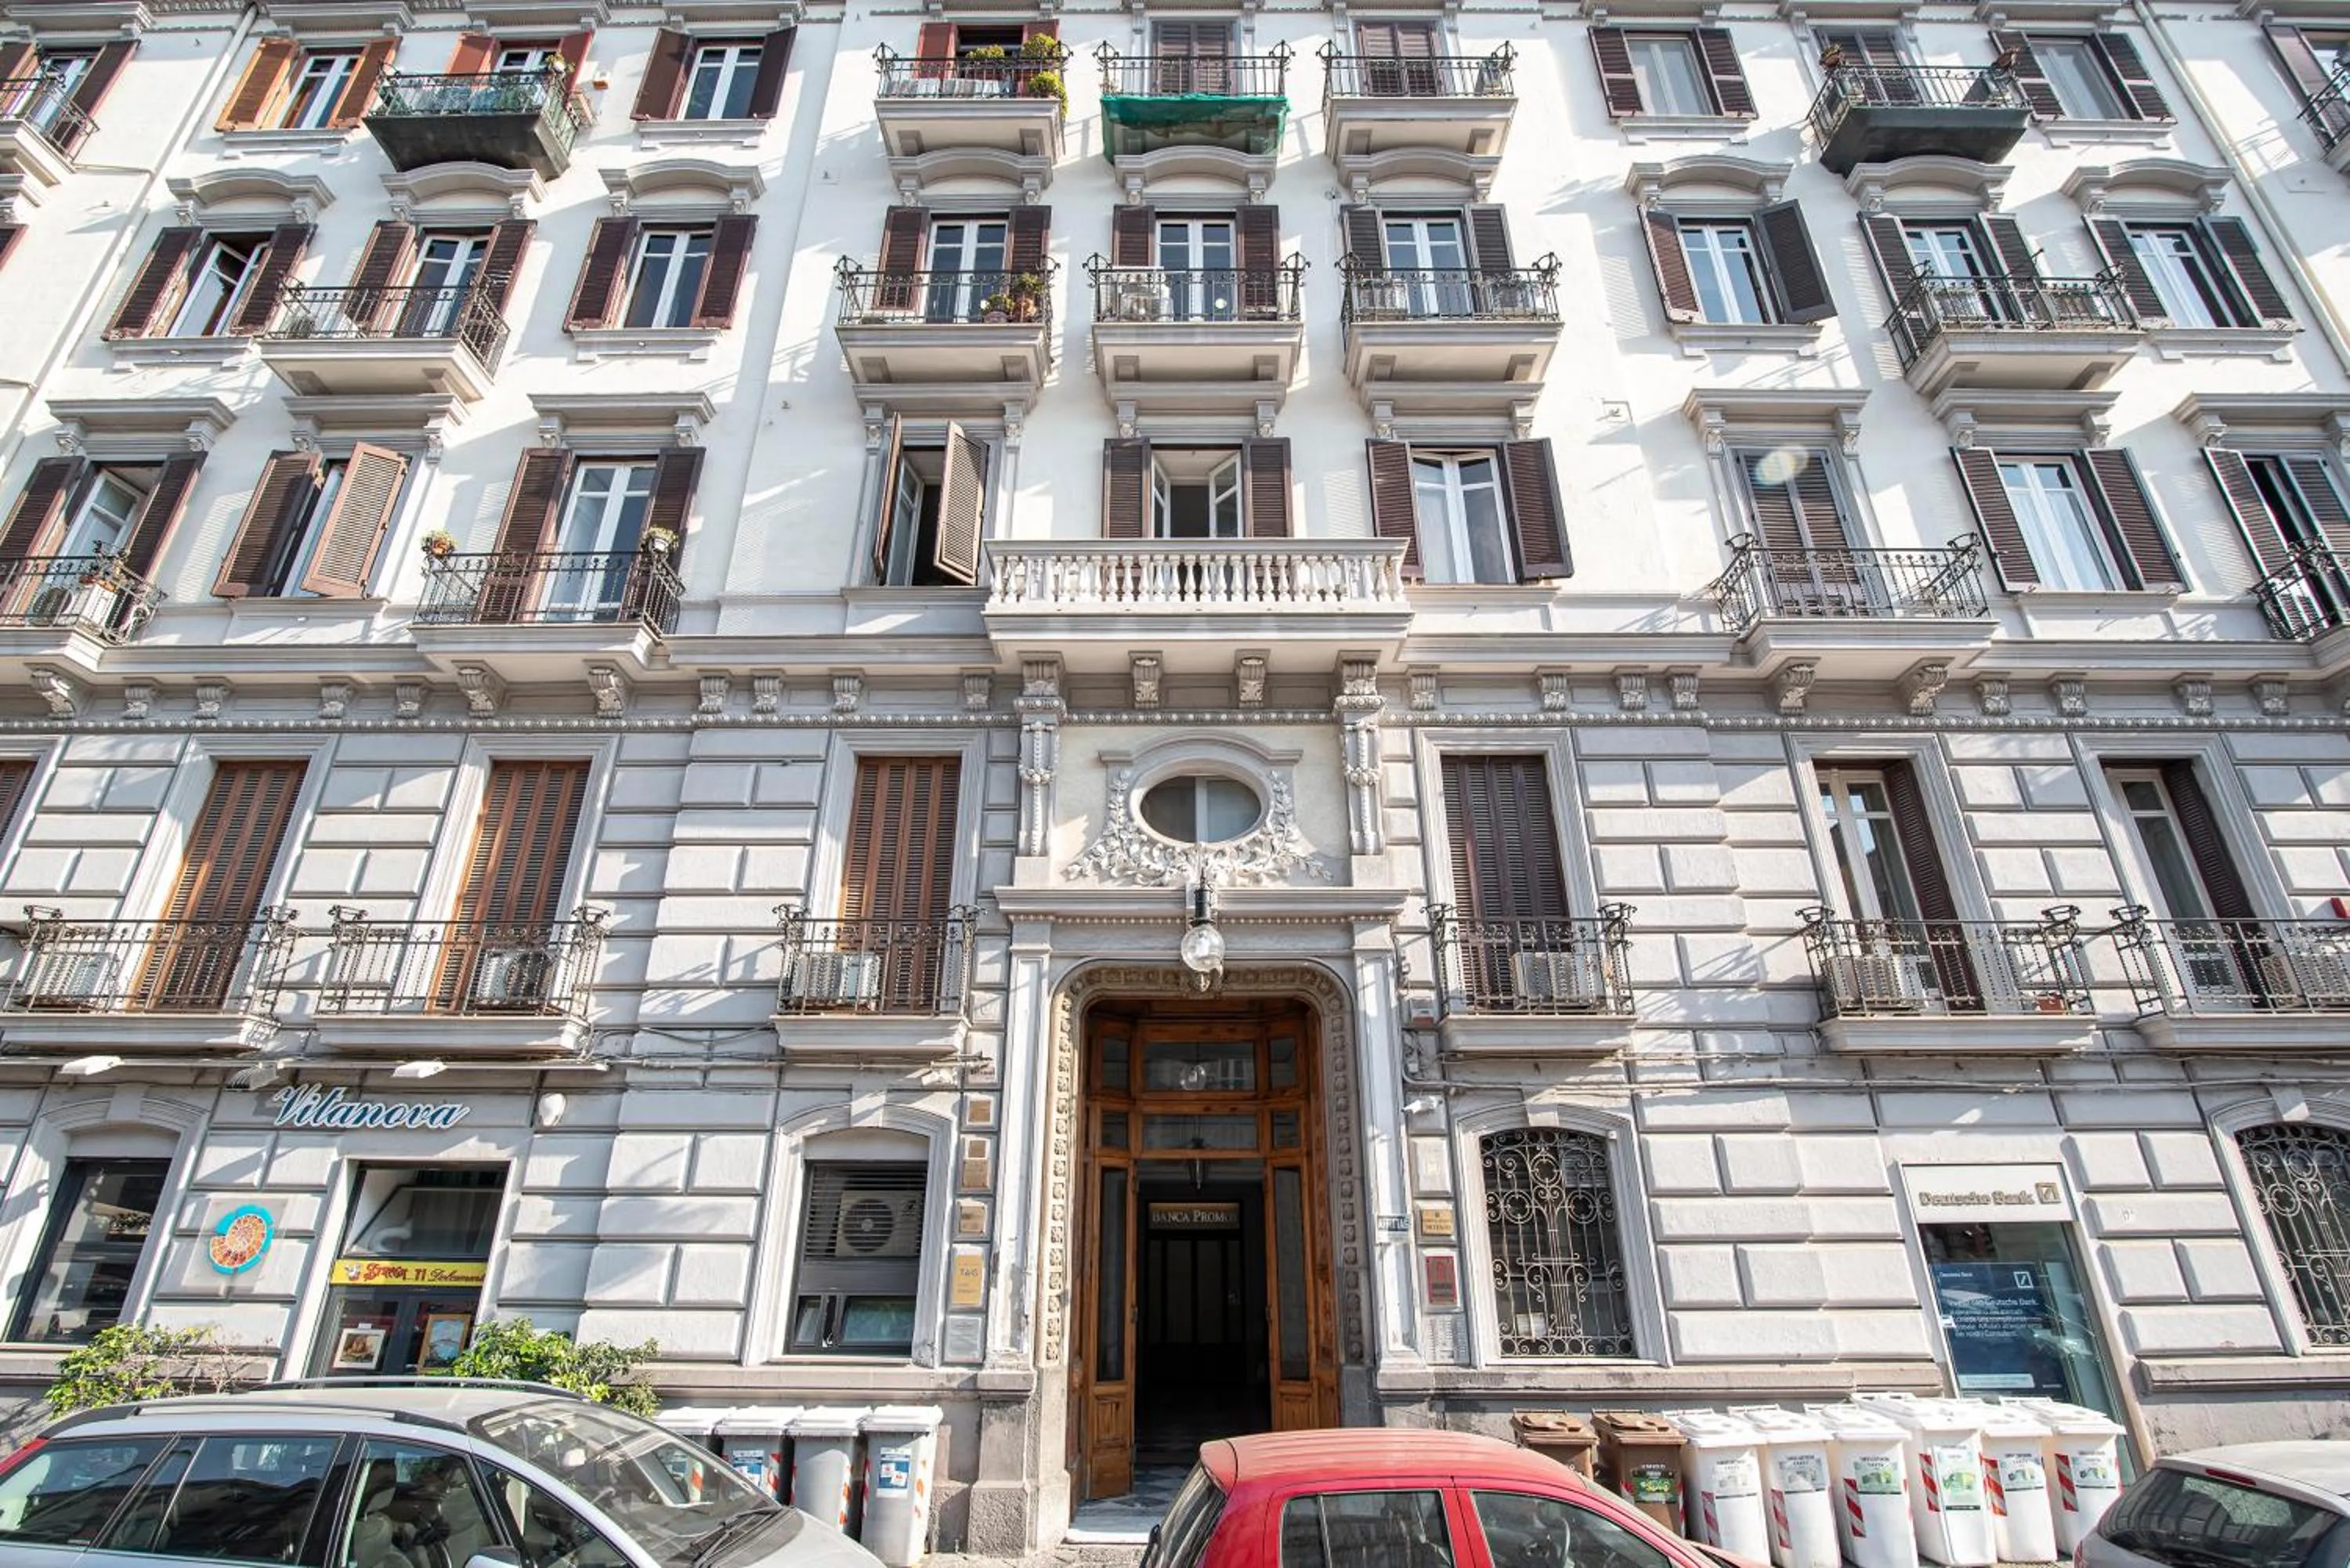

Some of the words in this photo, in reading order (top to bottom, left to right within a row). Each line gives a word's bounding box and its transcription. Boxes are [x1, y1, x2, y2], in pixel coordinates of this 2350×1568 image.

[1919, 1191, 1990, 1205] Deutsche
[1991, 1190, 2035, 1205] Bank
[1152, 1211, 1190, 1223] BANCA
